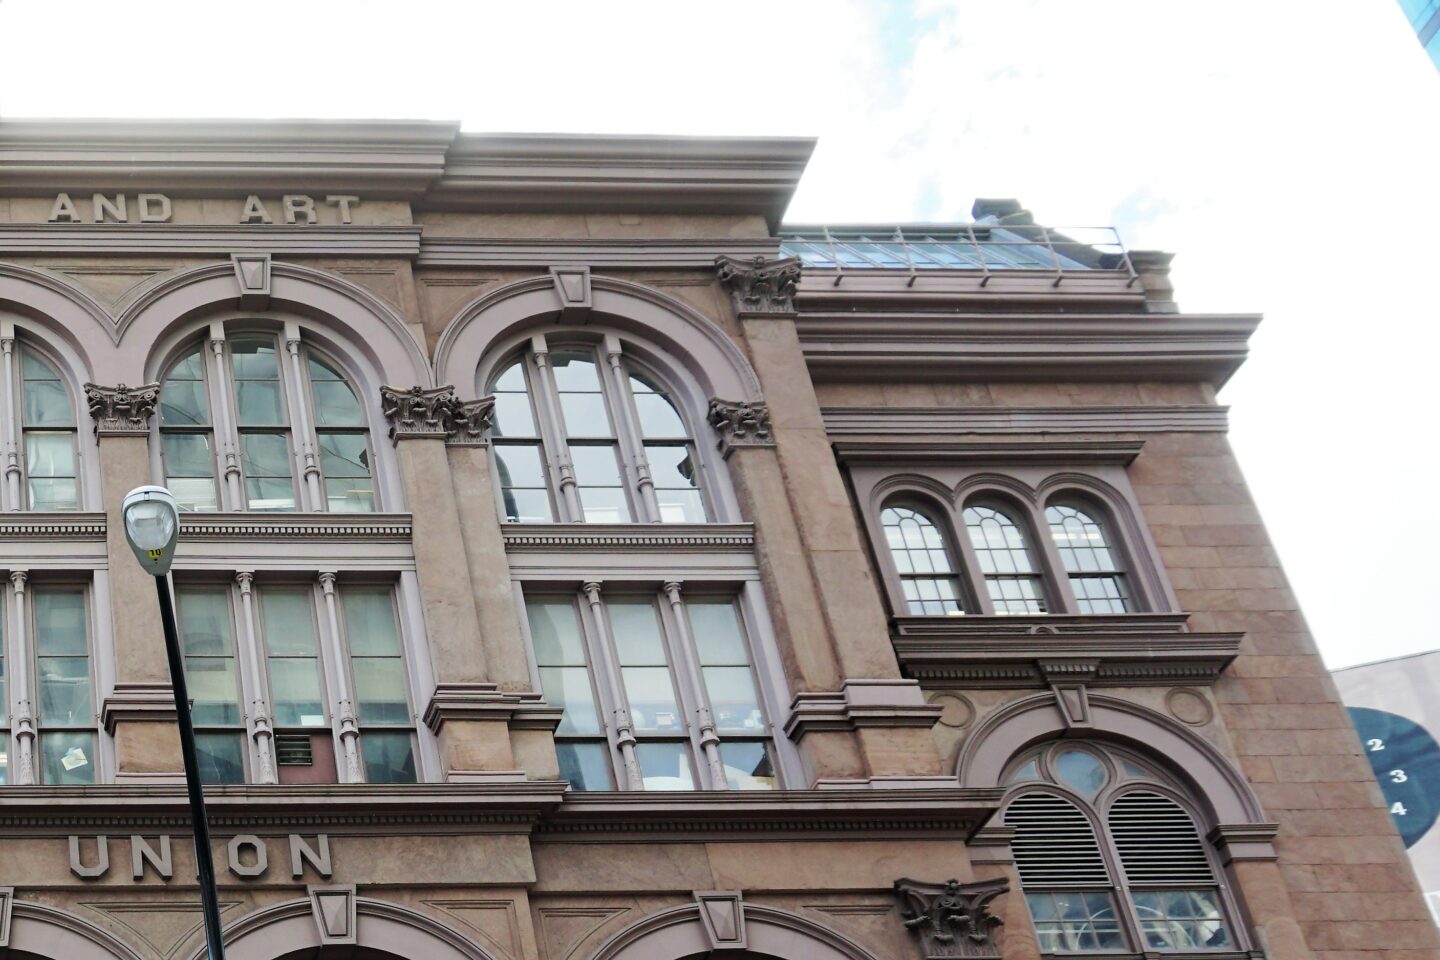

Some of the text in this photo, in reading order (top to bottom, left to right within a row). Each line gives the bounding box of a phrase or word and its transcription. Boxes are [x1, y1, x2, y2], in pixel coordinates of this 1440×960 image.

[48, 193, 173, 223] AND
[240, 194, 359, 225] ART
[1366, 738, 1386, 752] 2
[1389, 769, 1408, 783] 3
[1390, 801, 1408, 815] 4
[67, 834, 333, 881] UNON
